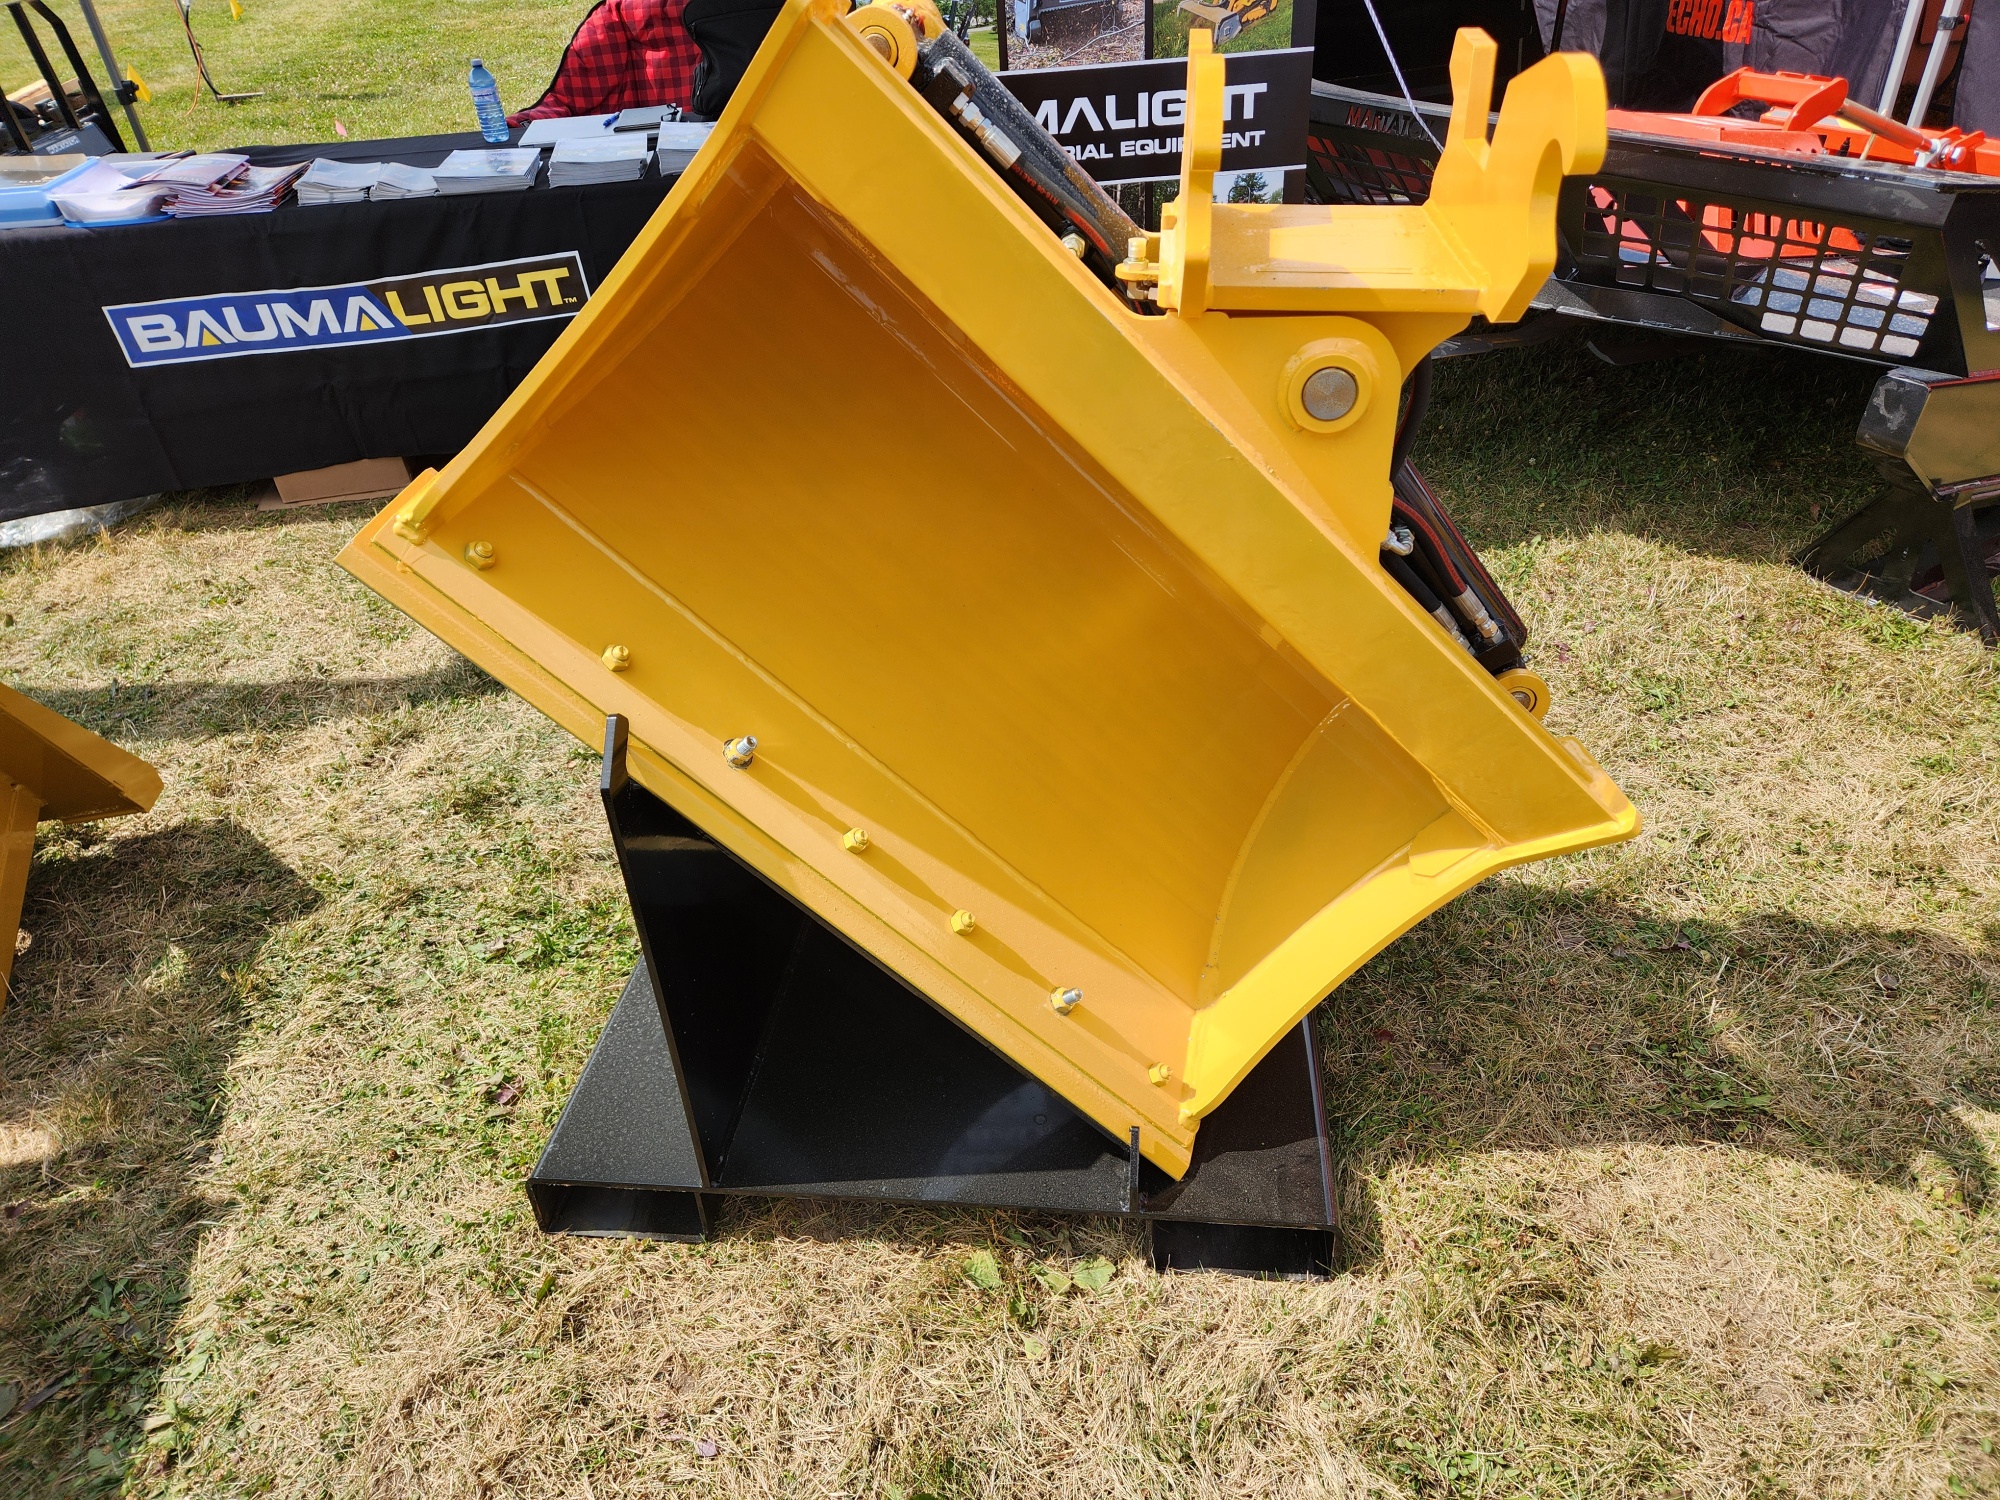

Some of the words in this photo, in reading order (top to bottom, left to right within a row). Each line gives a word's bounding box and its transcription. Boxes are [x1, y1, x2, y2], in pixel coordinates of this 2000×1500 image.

[1666, 0, 1754, 45] ECHO.CA
[1034, 83, 1267, 135] MALIGT
[1120, 130, 1266, 158] EQUIENT
[126, 266, 570, 353] BAUMALIGHT
